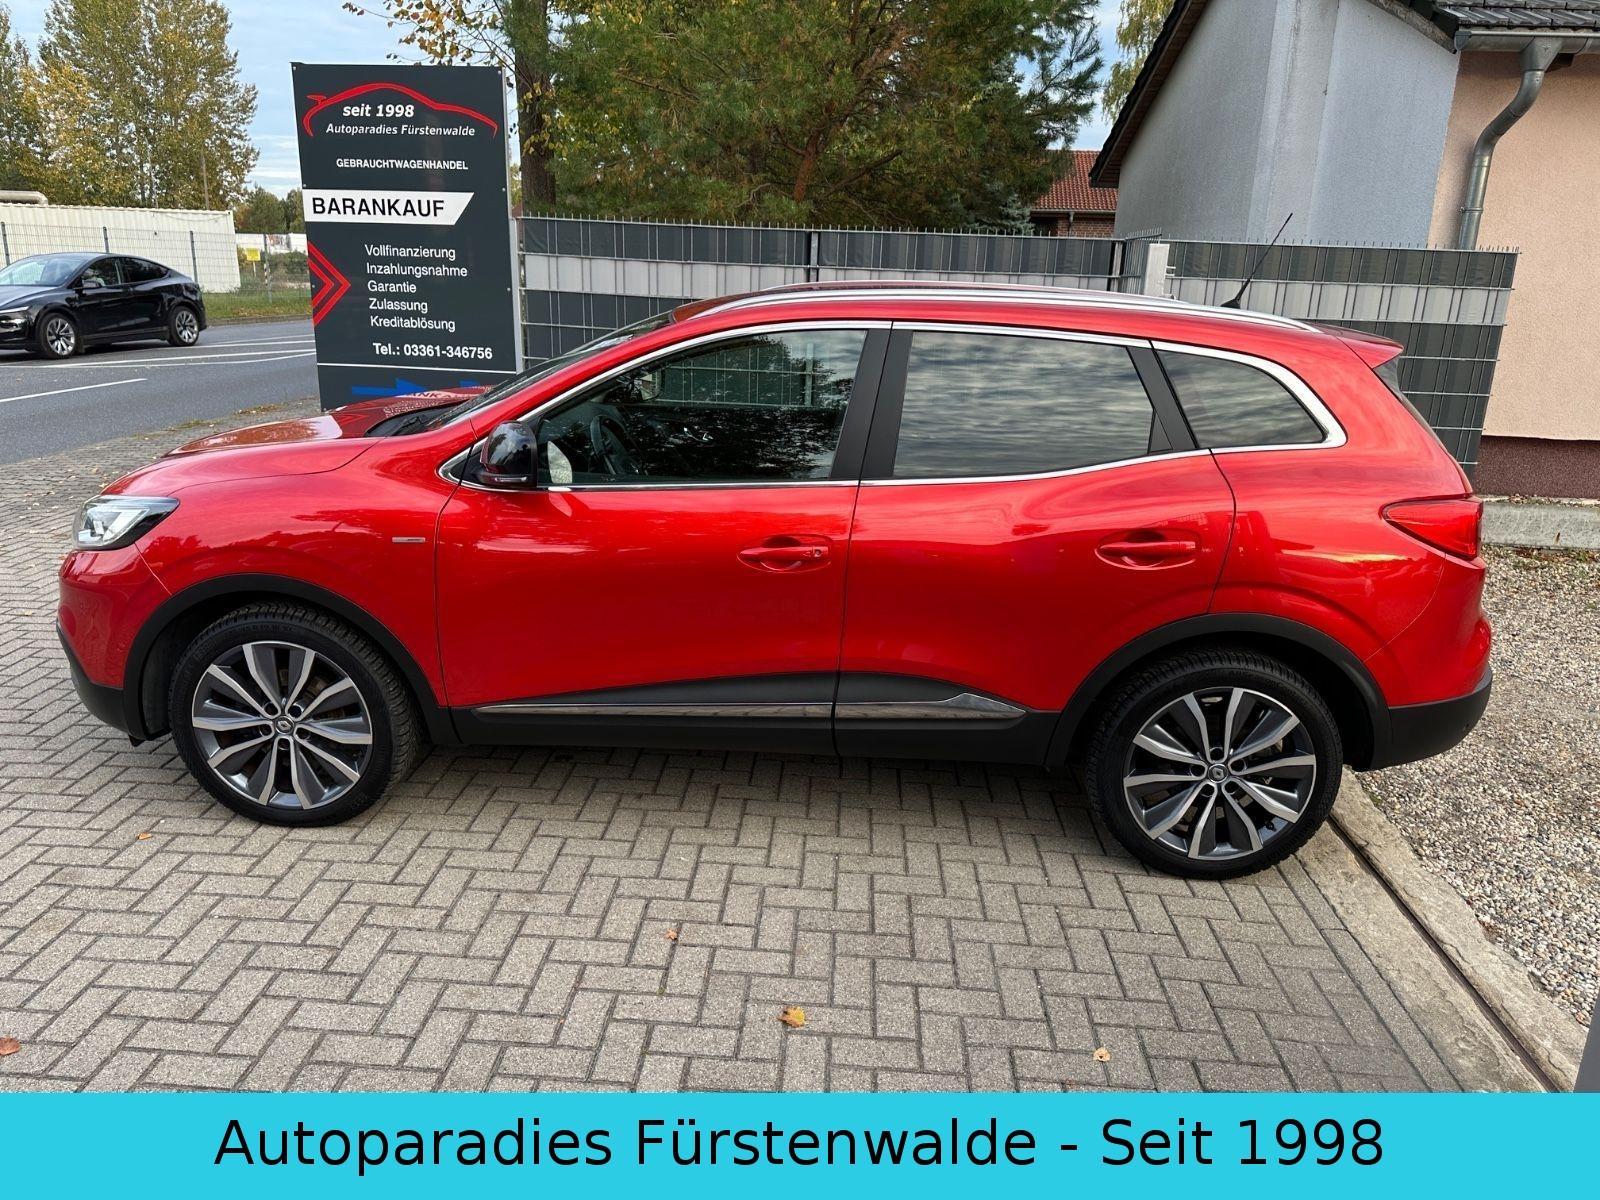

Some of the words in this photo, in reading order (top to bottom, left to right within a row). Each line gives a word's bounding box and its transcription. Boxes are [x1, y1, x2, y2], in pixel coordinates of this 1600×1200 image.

[342, 104, 371, 117] seit
[375, 104, 415, 118] 1998
[325, 122, 398, 135] Autoparadies
[400, 123, 476, 137] Fürstenwalde
[335, 158, 469, 170] GEBRAUCHTWAGENHANDEL
[312, 197, 445, 217] BARANKAUF
[364, 244, 456, 261] Vollfinanzierung
[366, 263, 468, 278] Inzahlungsnahme
[367, 280, 417, 293] Garantie
[369, 298, 428, 314] Zulassung
[370, 315, 456, 332] Kreditablösung
[372, 342, 401, 355] Tel.:
[403, 344, 493, 360] 03361-346756
